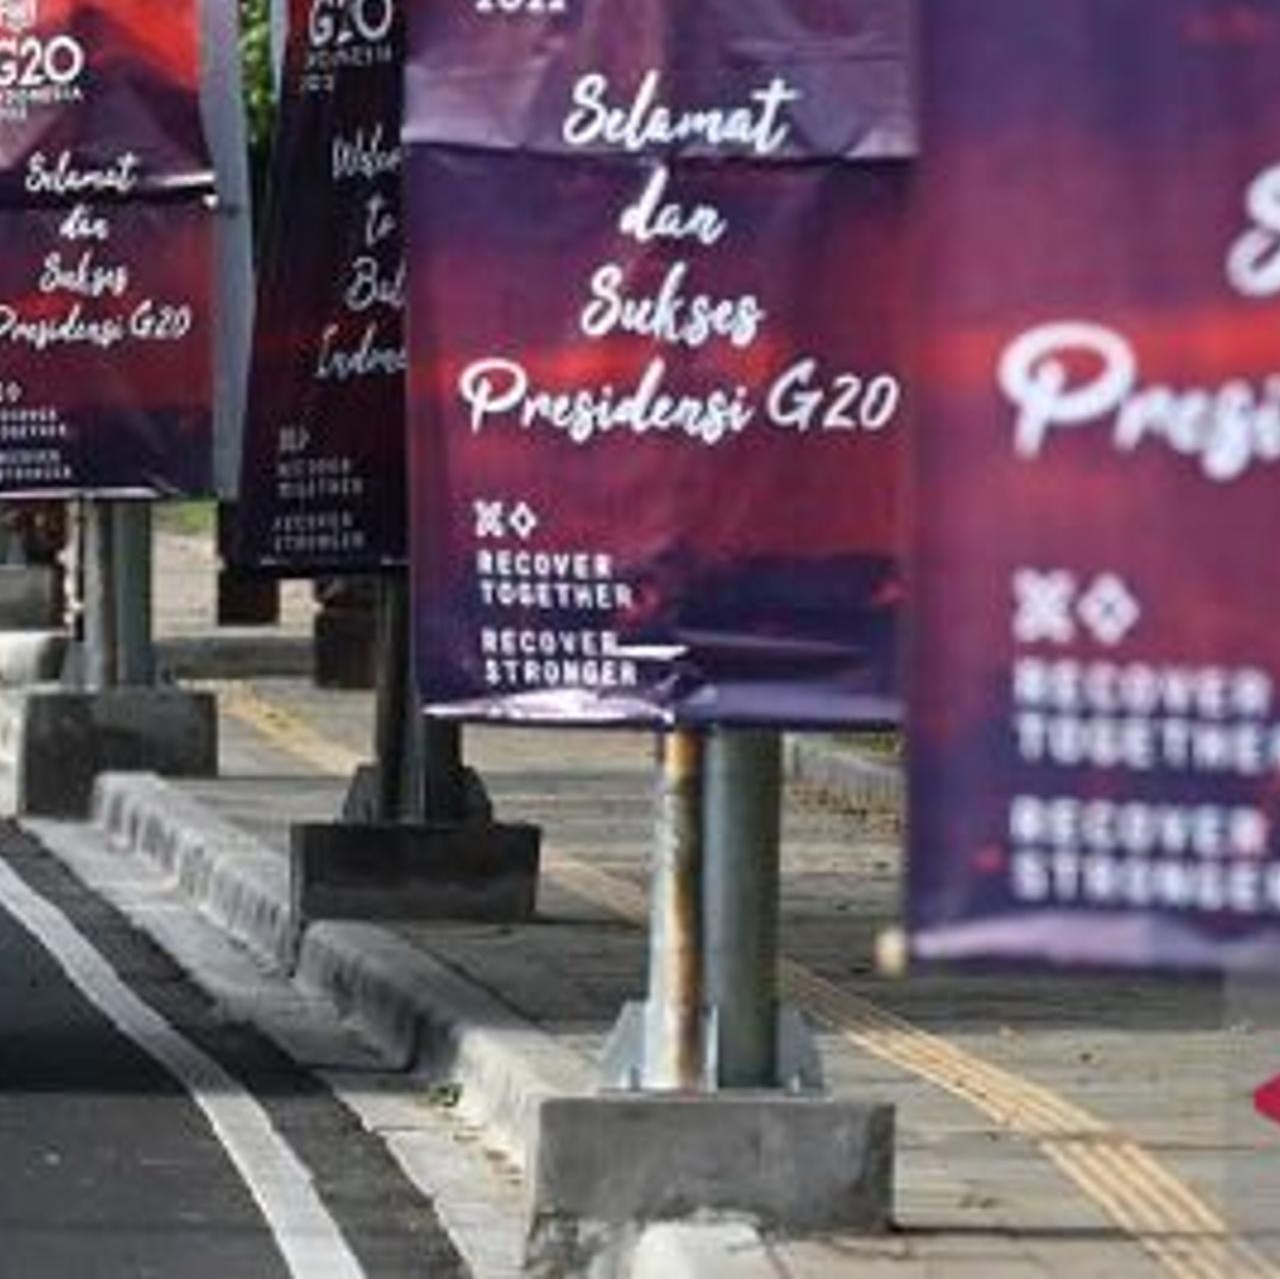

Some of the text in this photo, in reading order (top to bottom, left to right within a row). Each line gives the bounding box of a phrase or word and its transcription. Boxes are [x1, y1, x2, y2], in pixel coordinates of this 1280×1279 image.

[563, 70, 802, 152] Selamat
[25, 151, 139, 194] Selamat
[620, 166, 727, 242] dan
[129, 300, 191, 339] G20
[581, 262, 765, 347] Sukses
[459, 357, 900, 442] Presidensi G20
[477, 550, 612, 578] RECOVER
[480, 580, 633, 608] TOGETHER
[482, 628, 619, 656] RECOVER
[485, 659, 637, 686] STRONGER
